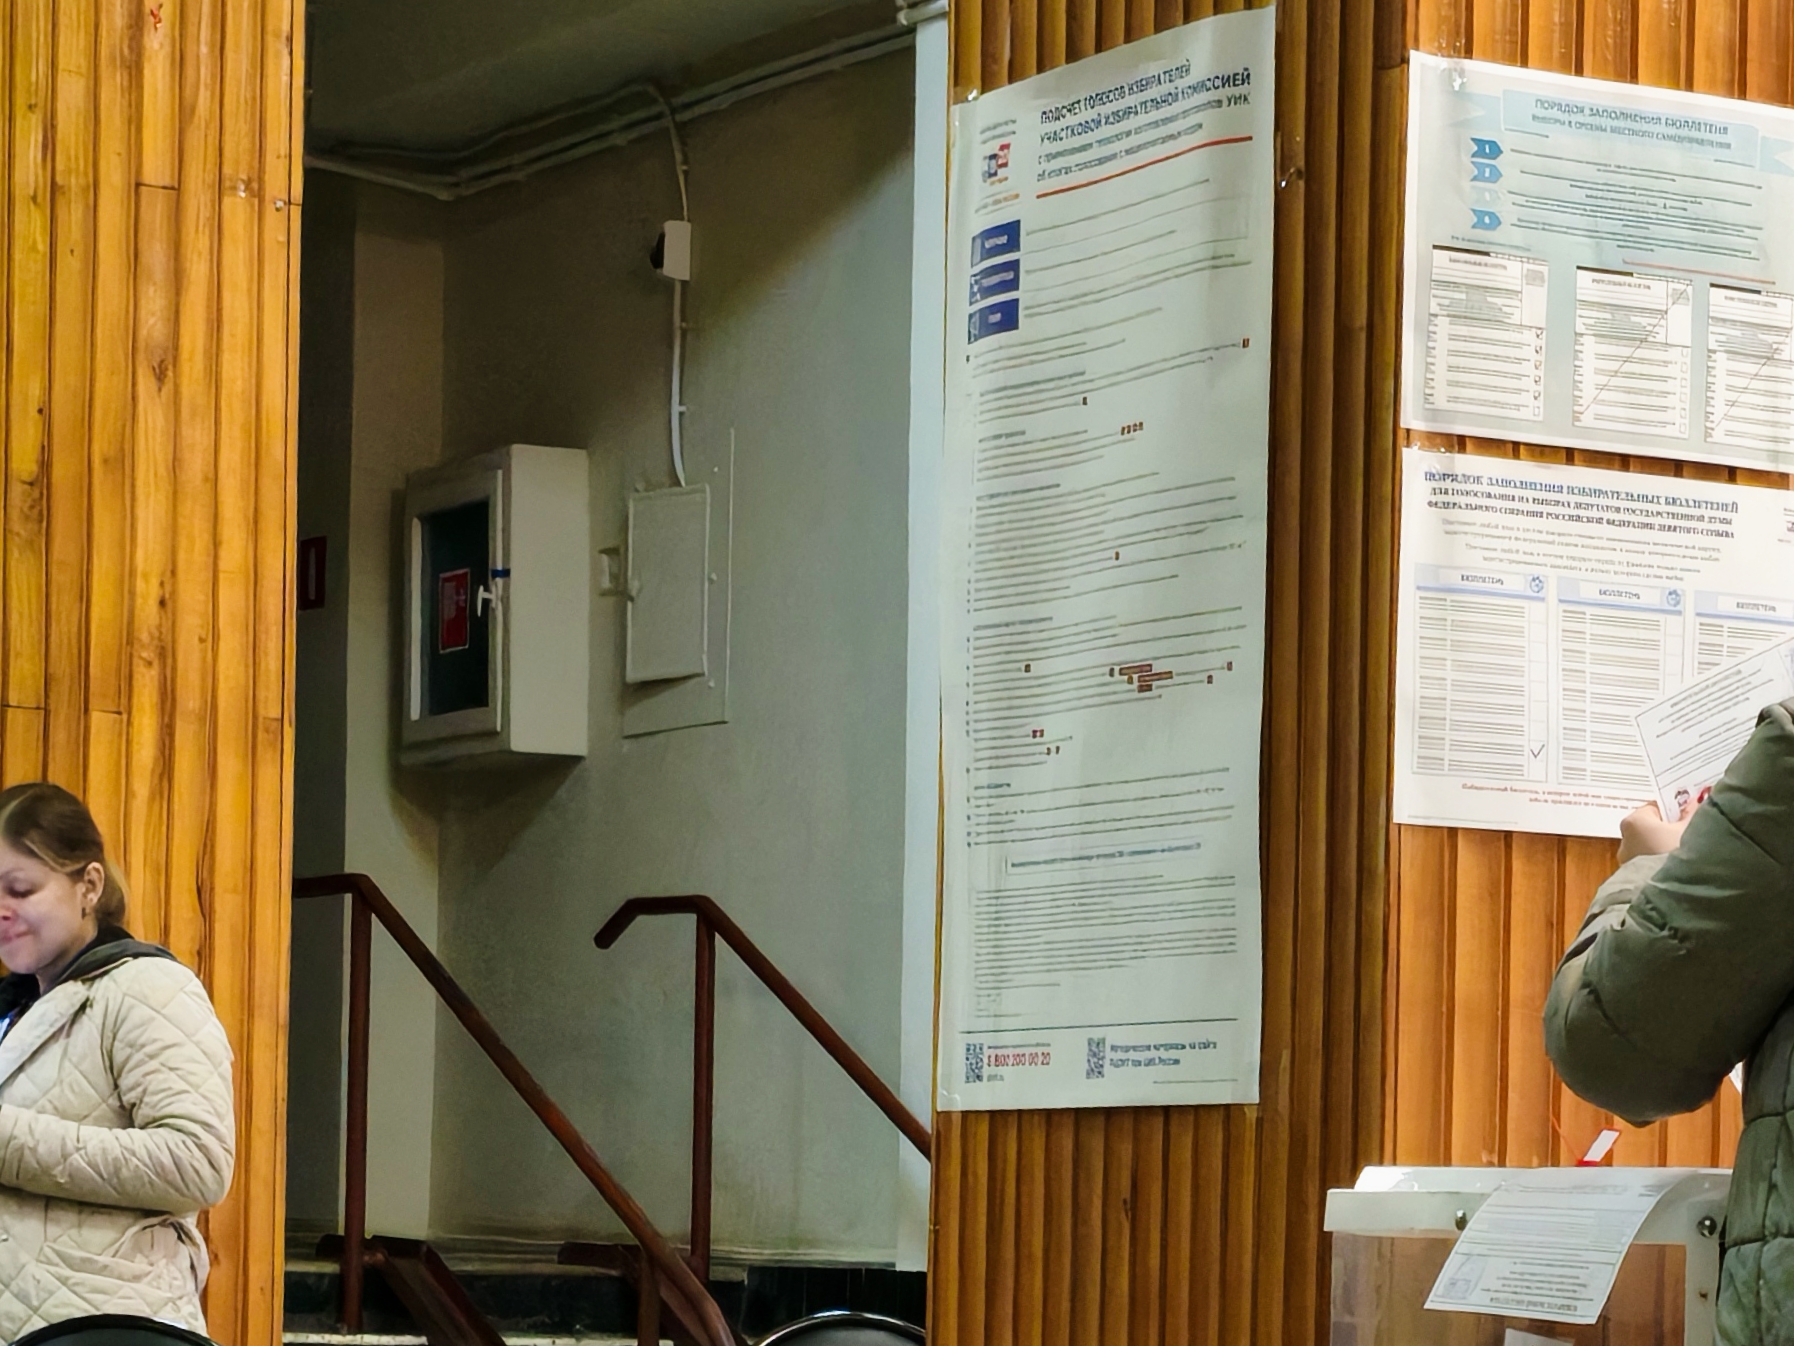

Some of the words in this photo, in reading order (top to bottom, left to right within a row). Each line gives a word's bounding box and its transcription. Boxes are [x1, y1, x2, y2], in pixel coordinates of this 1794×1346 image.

[1039, 113, 1102, 146] УЧАСТКОВОЙ
[1103, 86, 1180, 127] ИЗБИРАТЕЛЬНОЙ
[1181, 67, 1251, 98] КОМИССИЕЙ
[1040, 98, 1082, 125] ПОДСЧЕТ
[1225, 92, 1251, 108] УИК
[1535, 98, 1585, 117] ПОРЯДОК
[1588, 106, 1662, 126] ЗАПОЛНЕНИЯ
[1424, 470, 1484, 486] ПОРЯДОК
[1486, 476, 1564, 494] ЗАПОЛНЕНИЯ
[1566, 485, 1663, 507] ИЗБИРАТЕЛЬНЫХ
